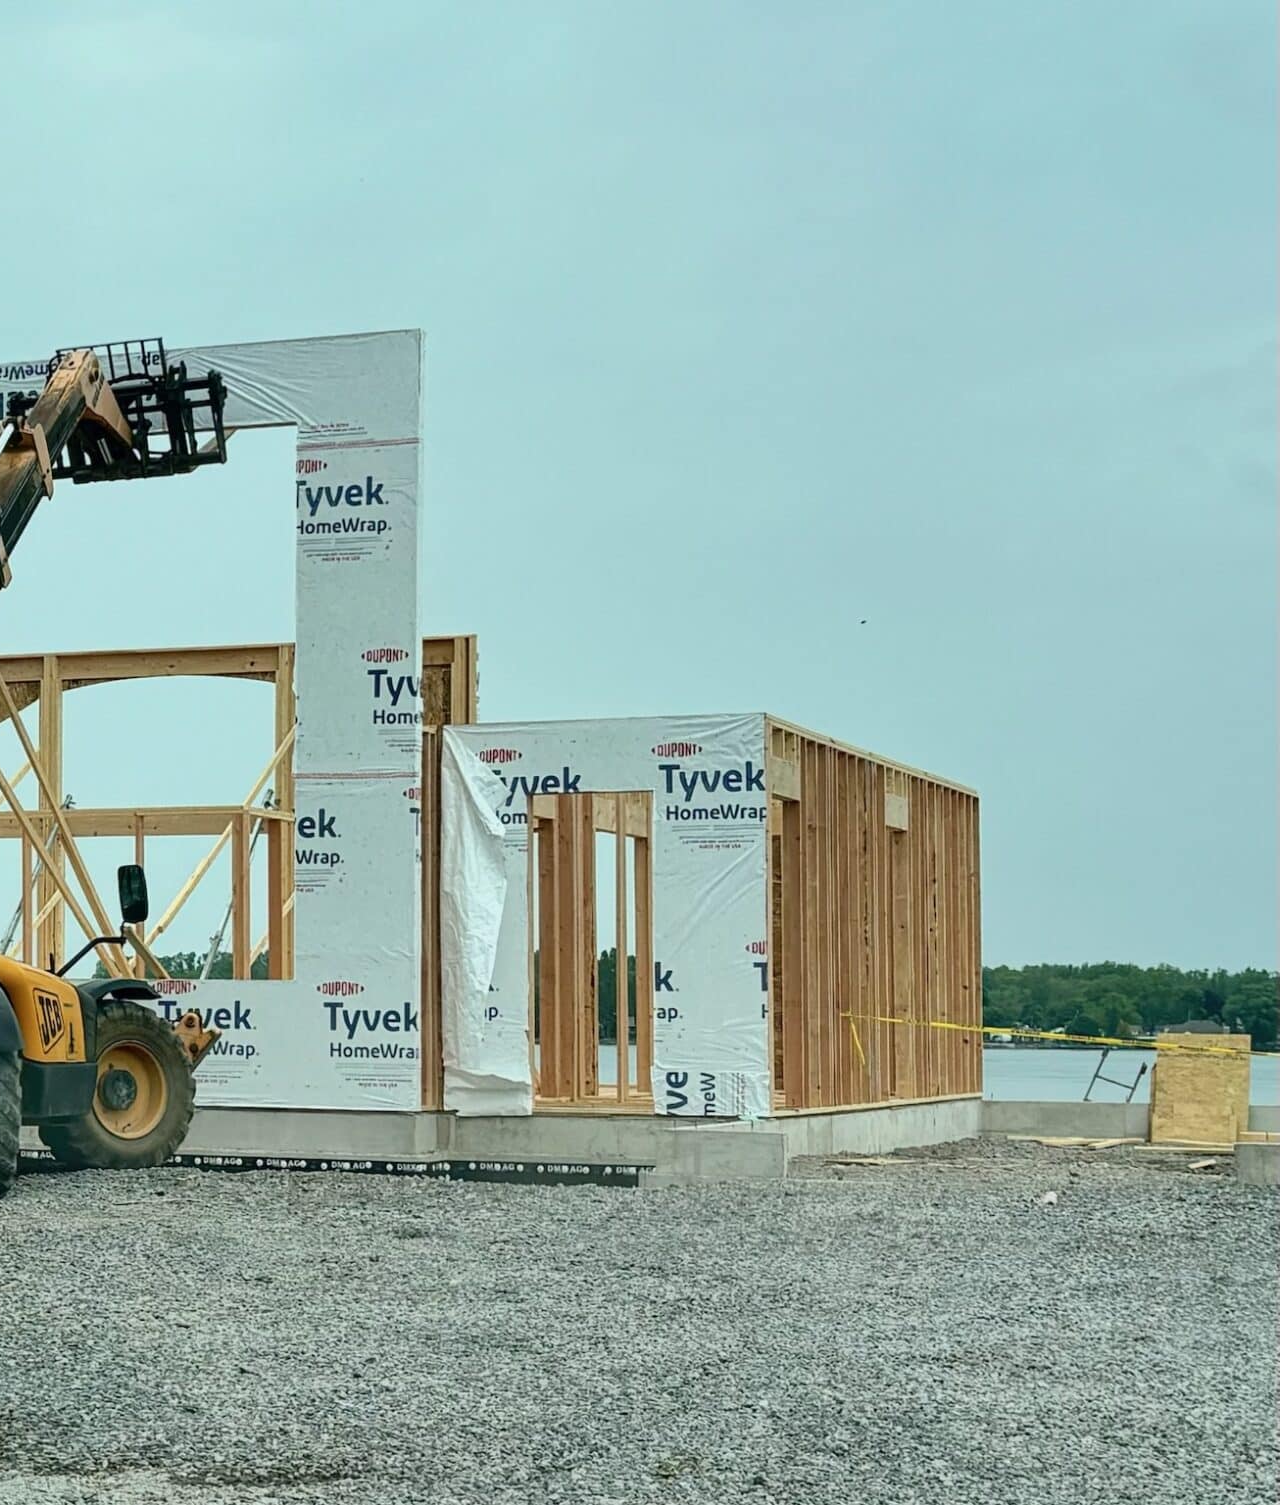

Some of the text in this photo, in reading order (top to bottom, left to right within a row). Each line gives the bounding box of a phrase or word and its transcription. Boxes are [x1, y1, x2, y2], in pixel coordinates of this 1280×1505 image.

[366, 648, 403, 663] DUPONT
[479, 748, 517, 763] DUPONT
[657, 742, 697, 758] DUPONT
[658, 761, 765, 802] Tyvek
[322, 981, 359, 996] DUPONT
[38, 995, 62, 1046] JCB
[323, 1001, 419, 1040] Tyvek
